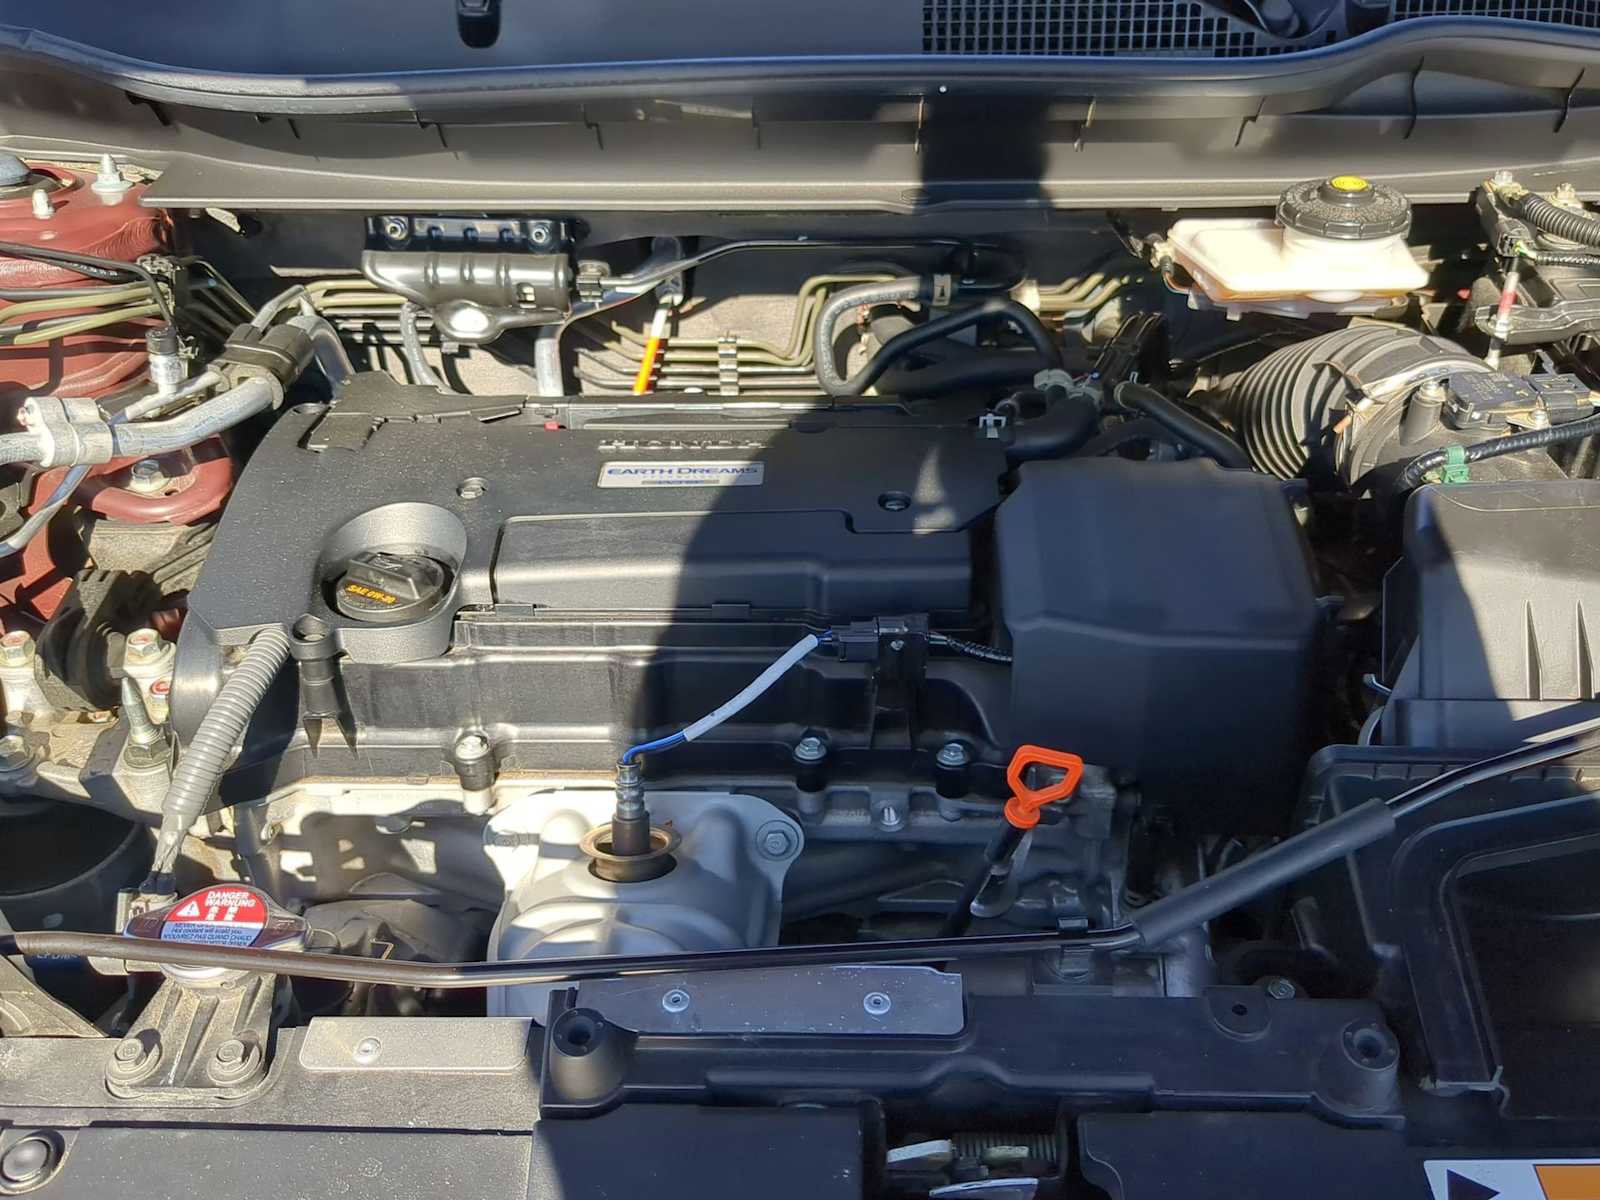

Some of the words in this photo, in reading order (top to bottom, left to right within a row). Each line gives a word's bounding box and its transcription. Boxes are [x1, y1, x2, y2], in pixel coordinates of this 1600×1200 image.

[607, 467, 672, 475] EARTH
[677, 466, 758, 475] DREAMS
[346, 585, 369, 595] SAE
[208, 891, 249, 900] DANGER
